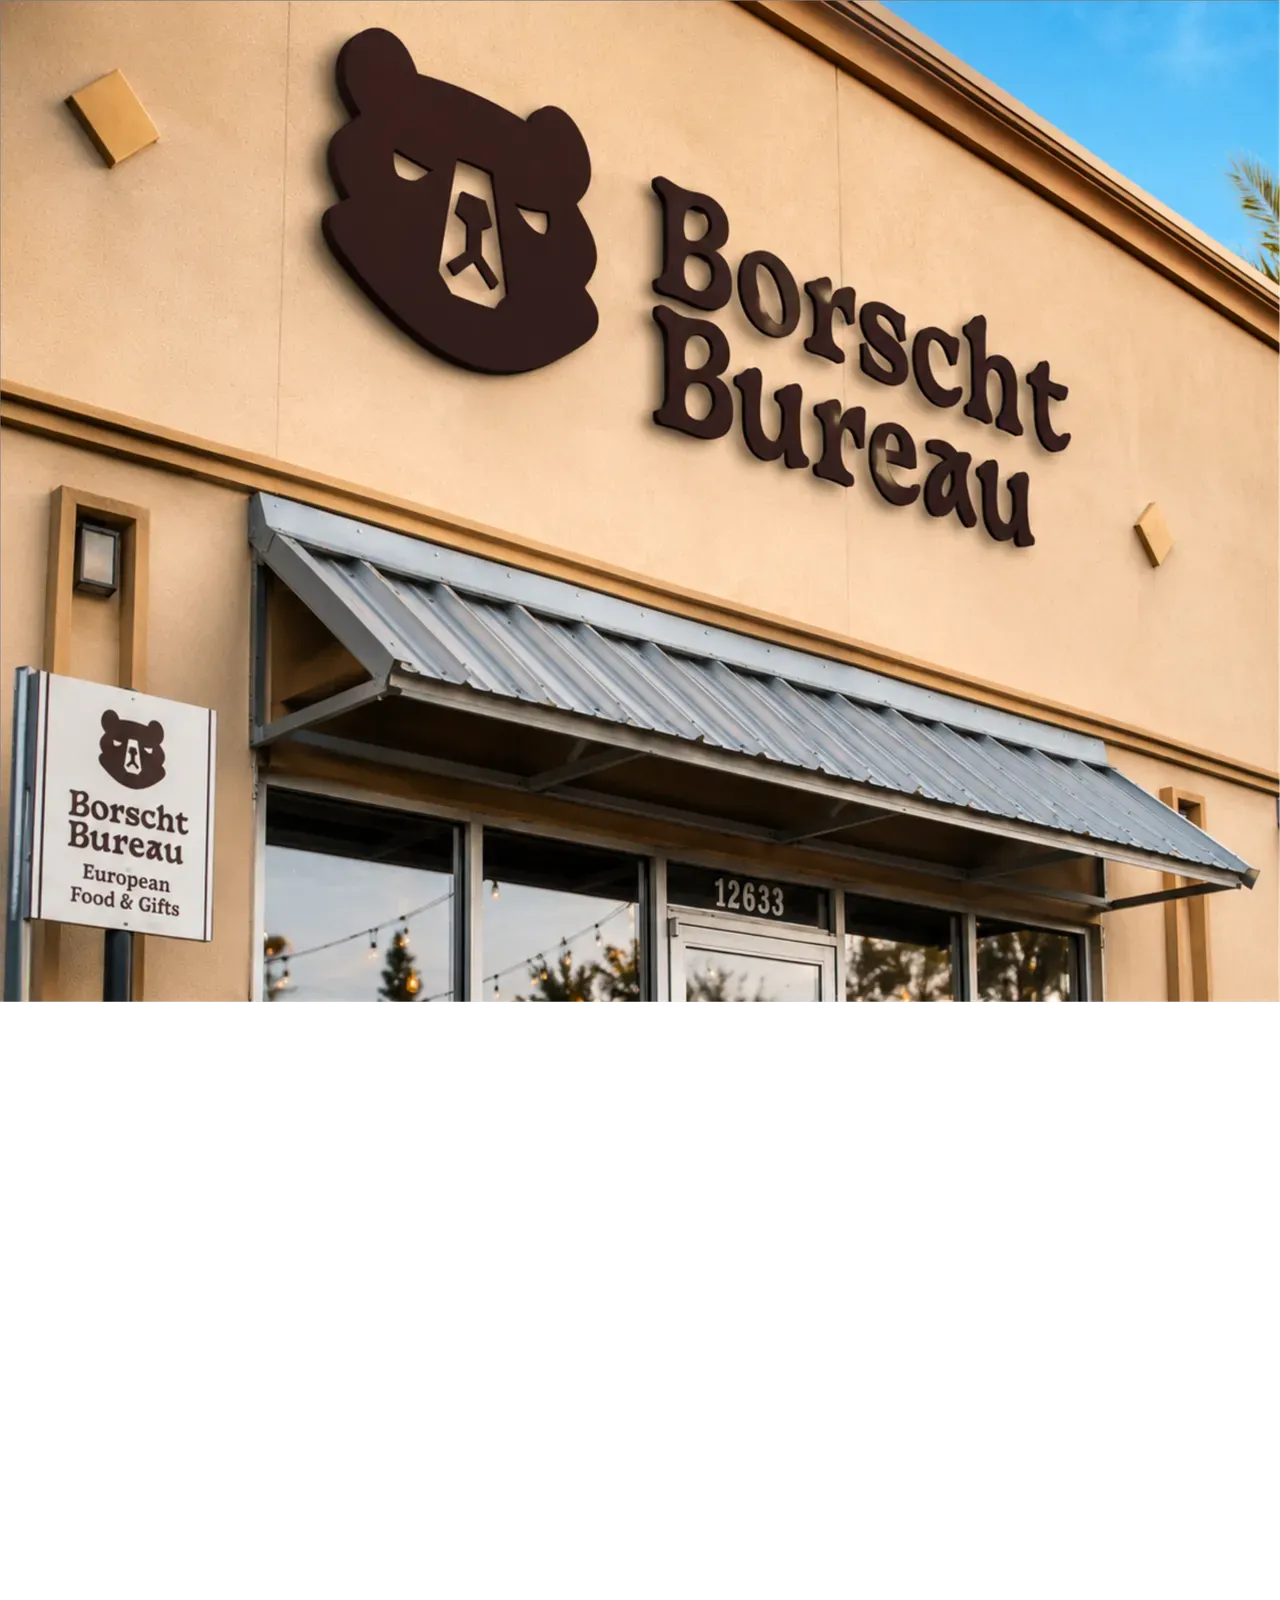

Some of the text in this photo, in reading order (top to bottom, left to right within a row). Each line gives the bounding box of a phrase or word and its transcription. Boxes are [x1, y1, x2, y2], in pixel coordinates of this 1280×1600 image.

[651, 176, 1072, 453] Borscht
[651, 304, 1036, 548] Bureau
[68, 788, 189, 835] Borscht
[67, 819, 183, 865] Bureau
[82, 863, 171, 893] European
[714, 877, 784, 916] 12633
[69, 886, 180, 917] Food & Gifts
